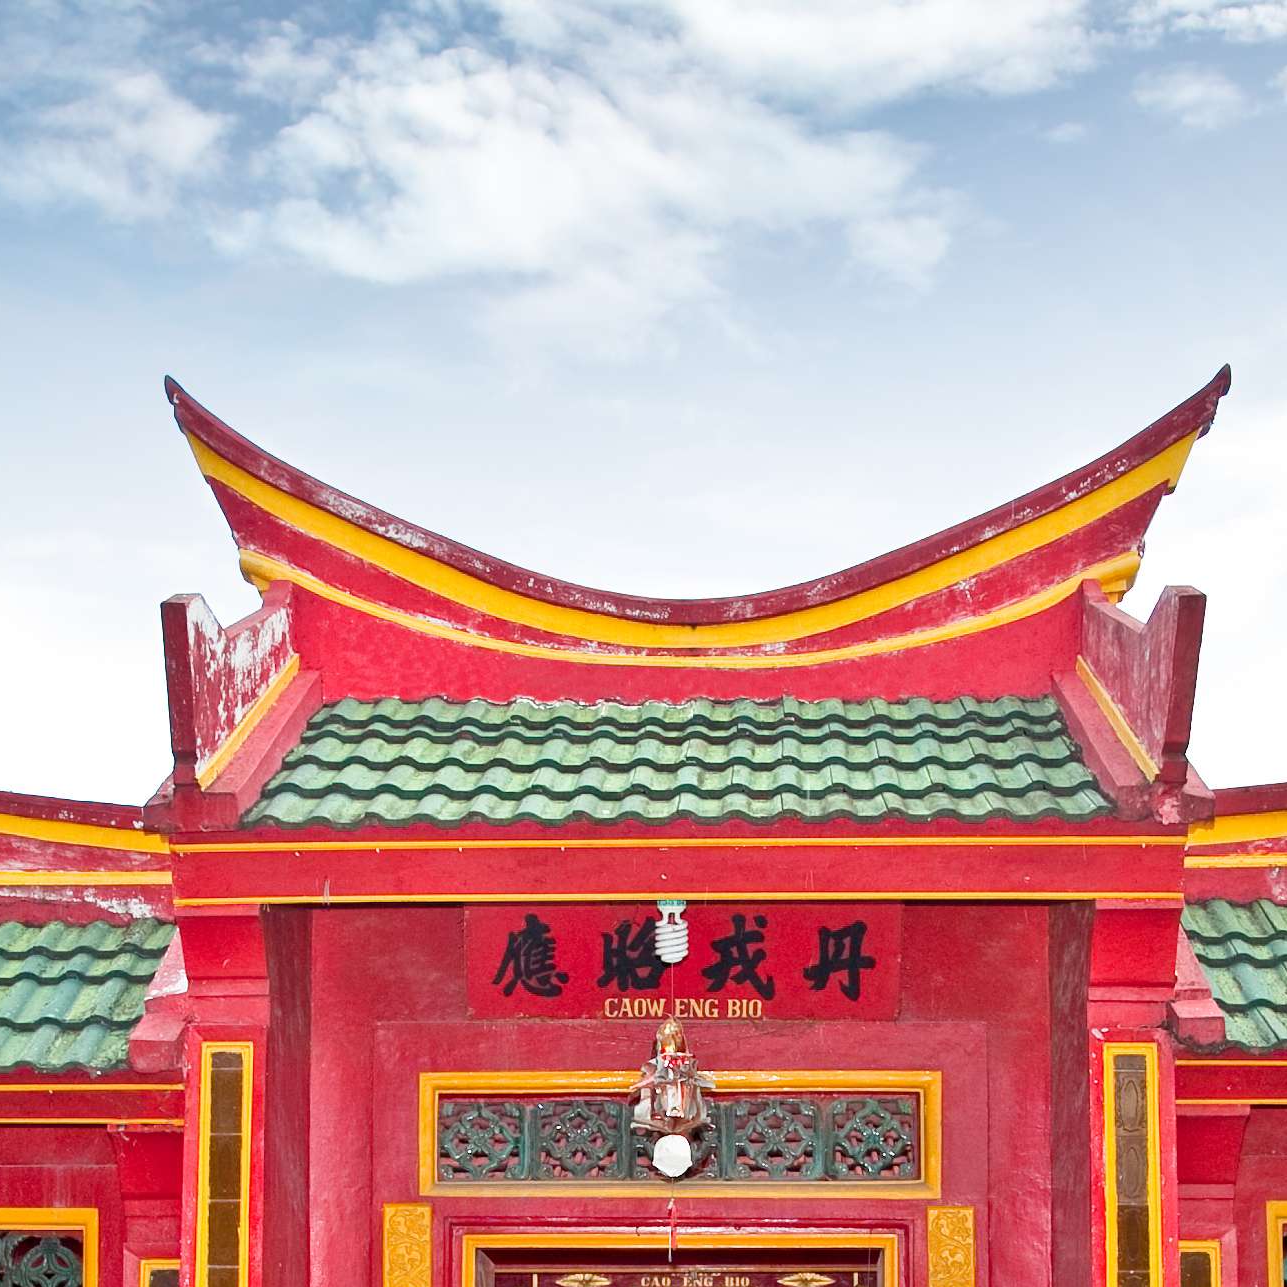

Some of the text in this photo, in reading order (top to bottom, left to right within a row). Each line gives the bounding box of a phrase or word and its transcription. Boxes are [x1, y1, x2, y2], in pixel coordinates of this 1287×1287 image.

[604, 998, 763, 1018] CAOW ENG BIO
[640, 1276, 750, 1287] CAO ENG BIO
